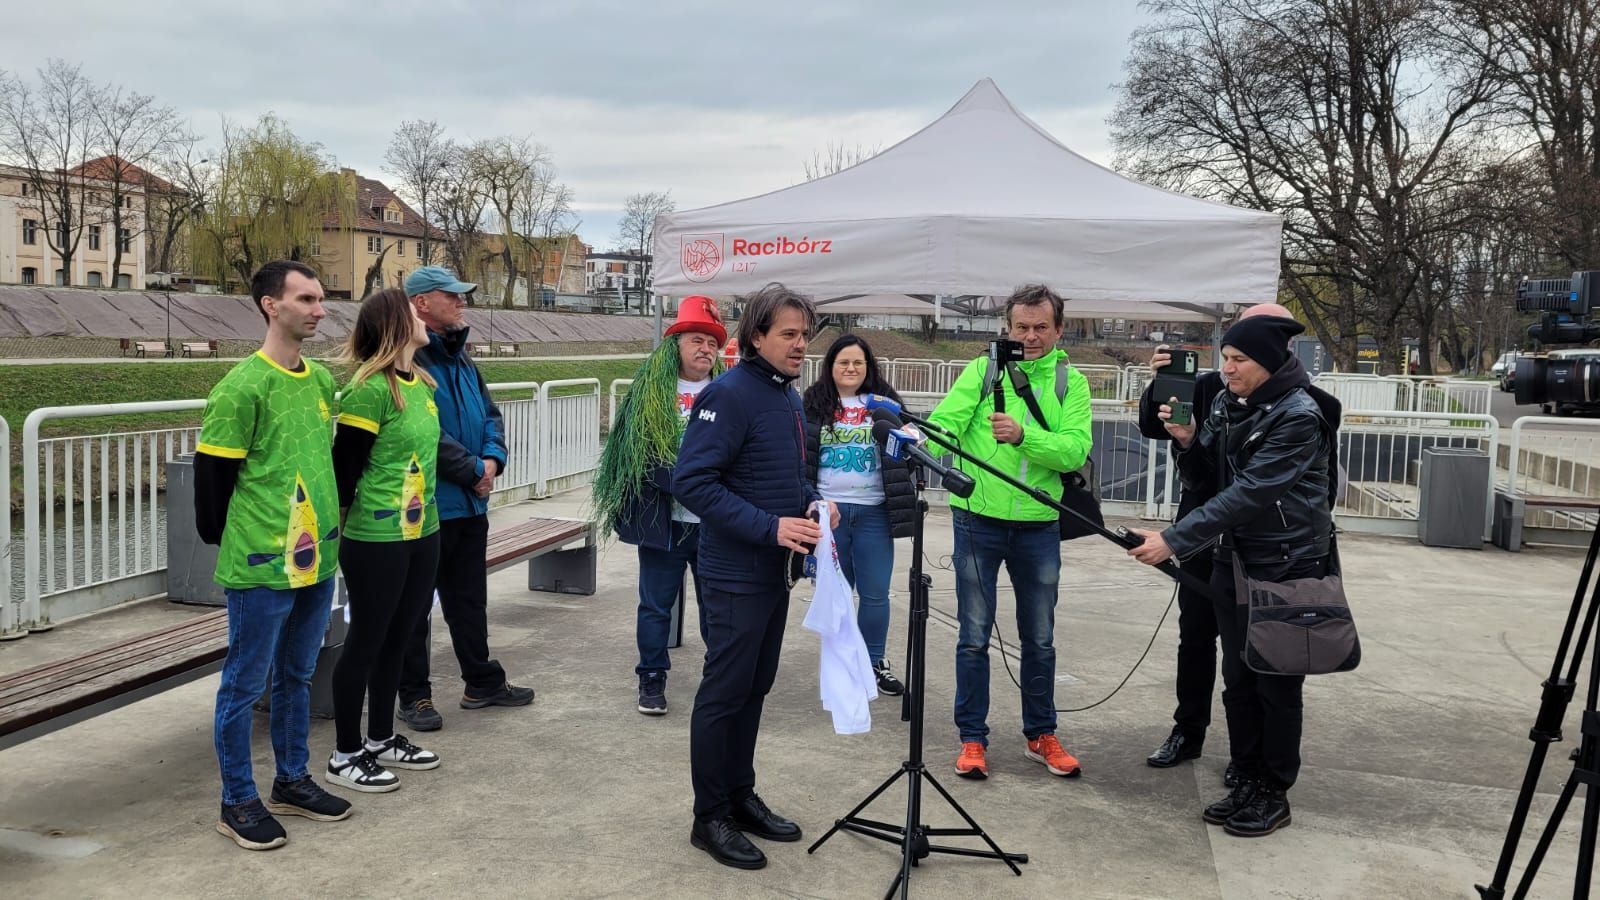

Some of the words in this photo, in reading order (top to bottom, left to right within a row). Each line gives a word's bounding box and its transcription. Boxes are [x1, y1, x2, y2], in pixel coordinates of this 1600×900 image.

[733, 236, 832, 256] Racibórz
[731, 261, 759, 276] 1217
[698, 408, 717, 422] HH
[819, 446, 877, 472] ODRA
